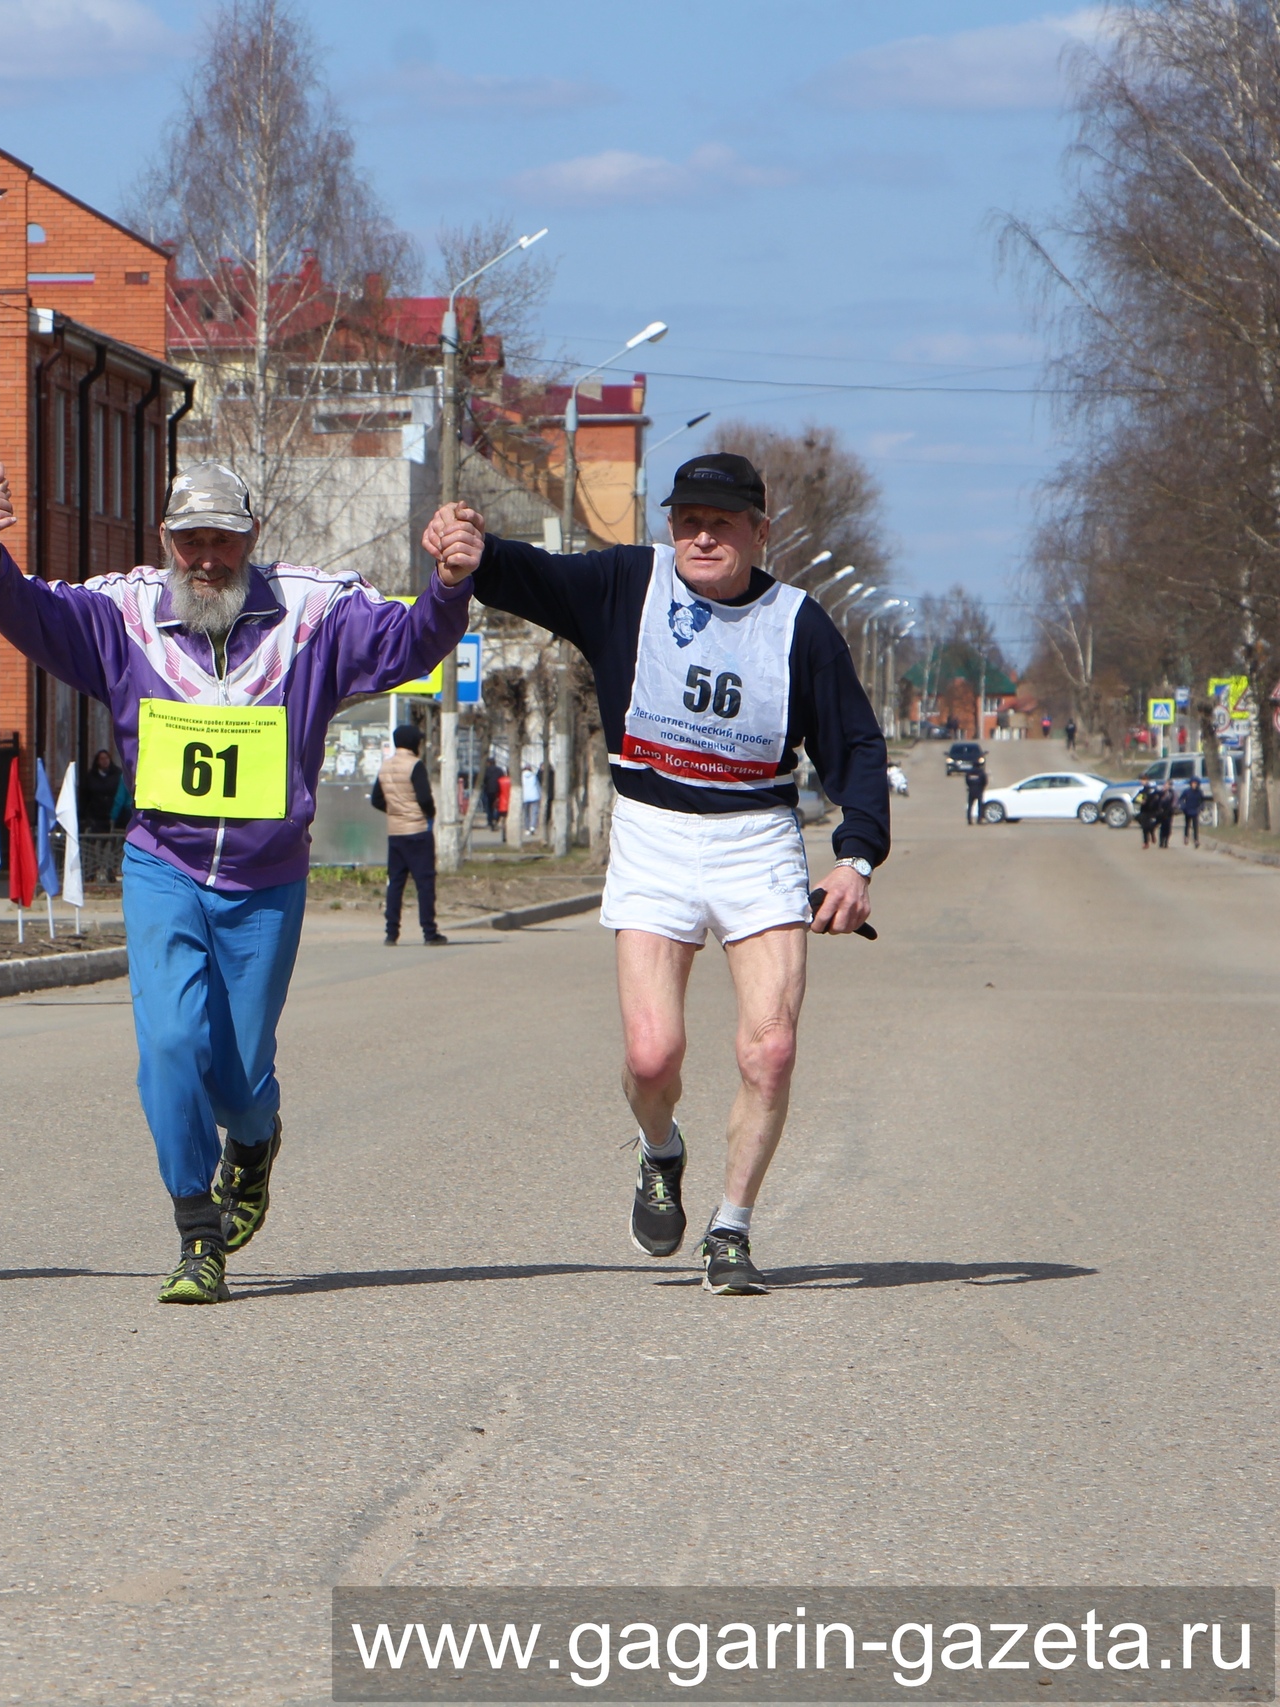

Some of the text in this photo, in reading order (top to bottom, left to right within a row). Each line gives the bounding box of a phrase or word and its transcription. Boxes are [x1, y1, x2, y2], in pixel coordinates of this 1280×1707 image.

[682, 663, 743, 719] 56
[632, 706, 775, 747] Легкоатлетический пробег
[659, 730, 737, 754] посвященный
[181, 741, 239, 798] 61
[633, 744, 662, 761] Дню
